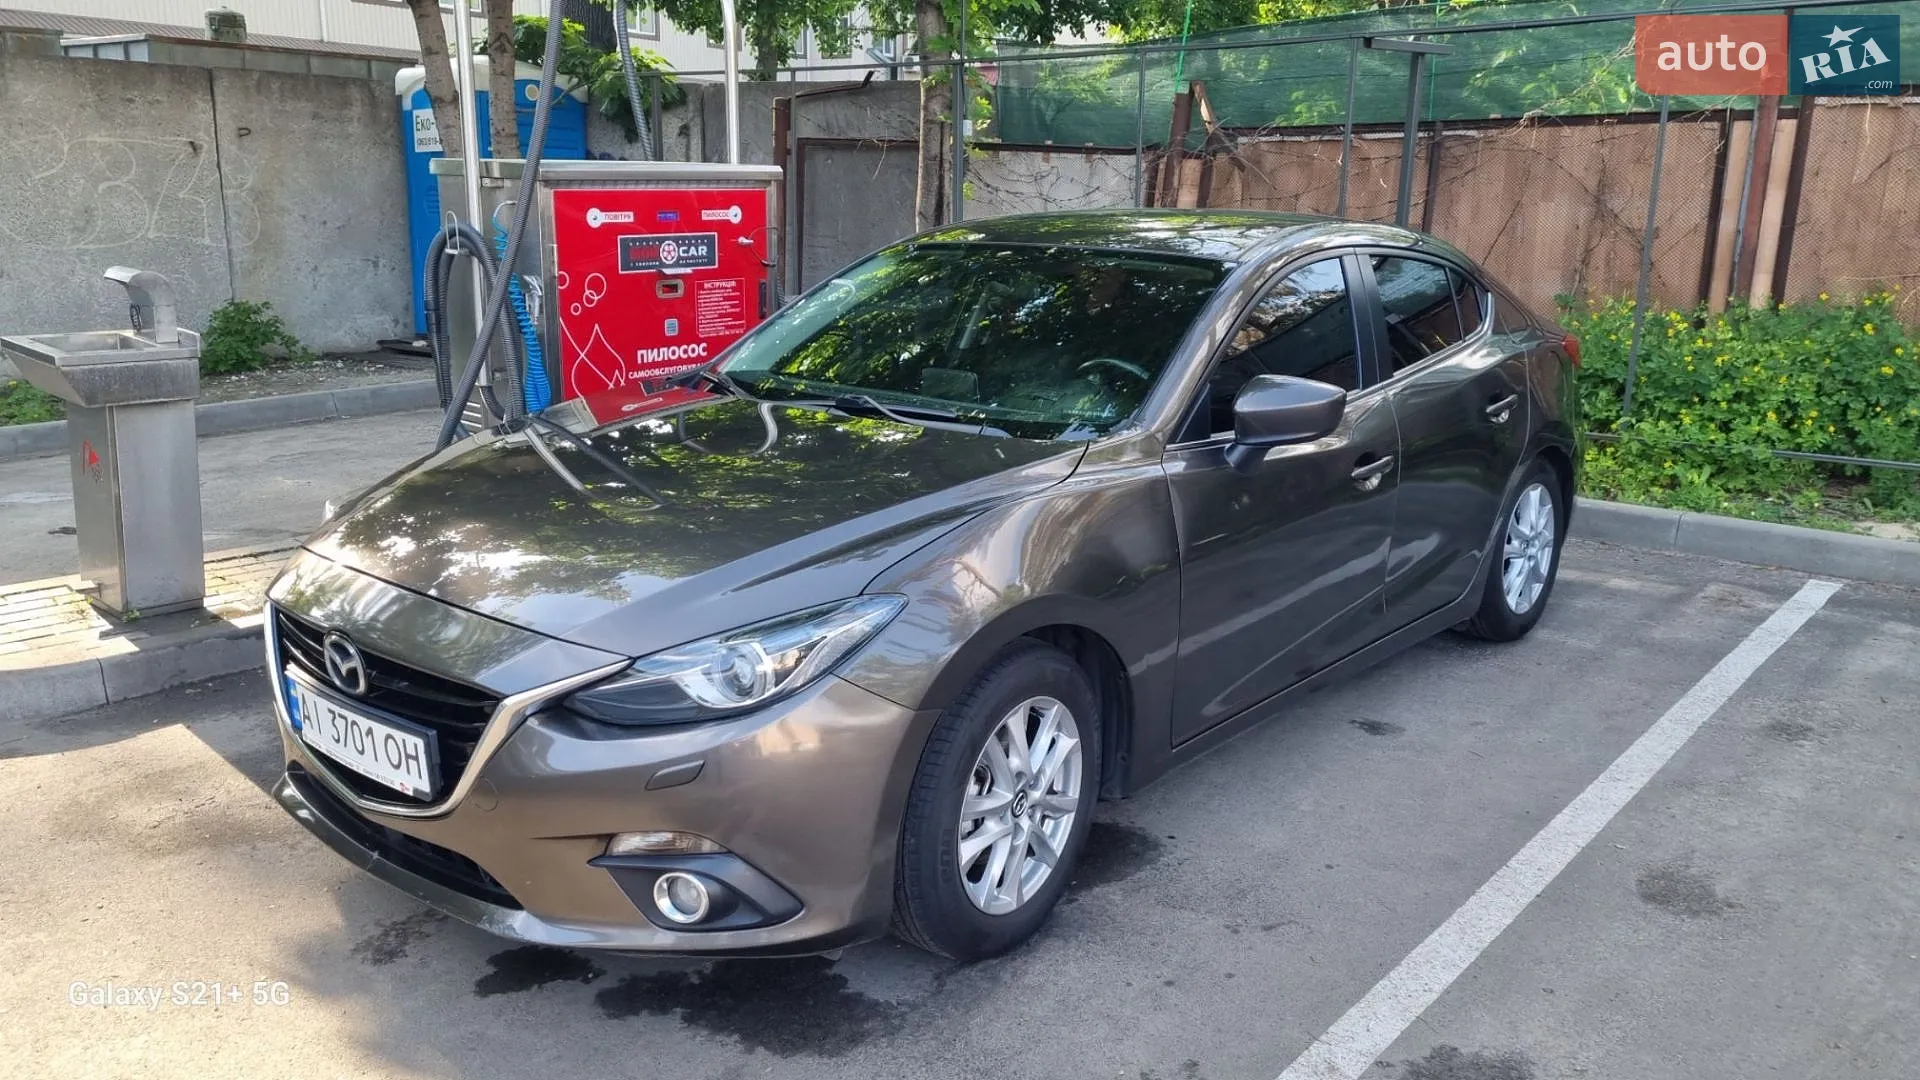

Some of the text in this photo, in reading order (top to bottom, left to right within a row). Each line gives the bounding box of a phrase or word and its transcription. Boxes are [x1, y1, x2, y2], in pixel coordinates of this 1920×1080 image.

[679, 245, 708, 257] CAR
[637, 342, 708, 364] ПИЛОСОС
[301, 692, 322, 736] AI
[327, 708, 378, 763] 3701
[384, 733, 423, 781] OH
